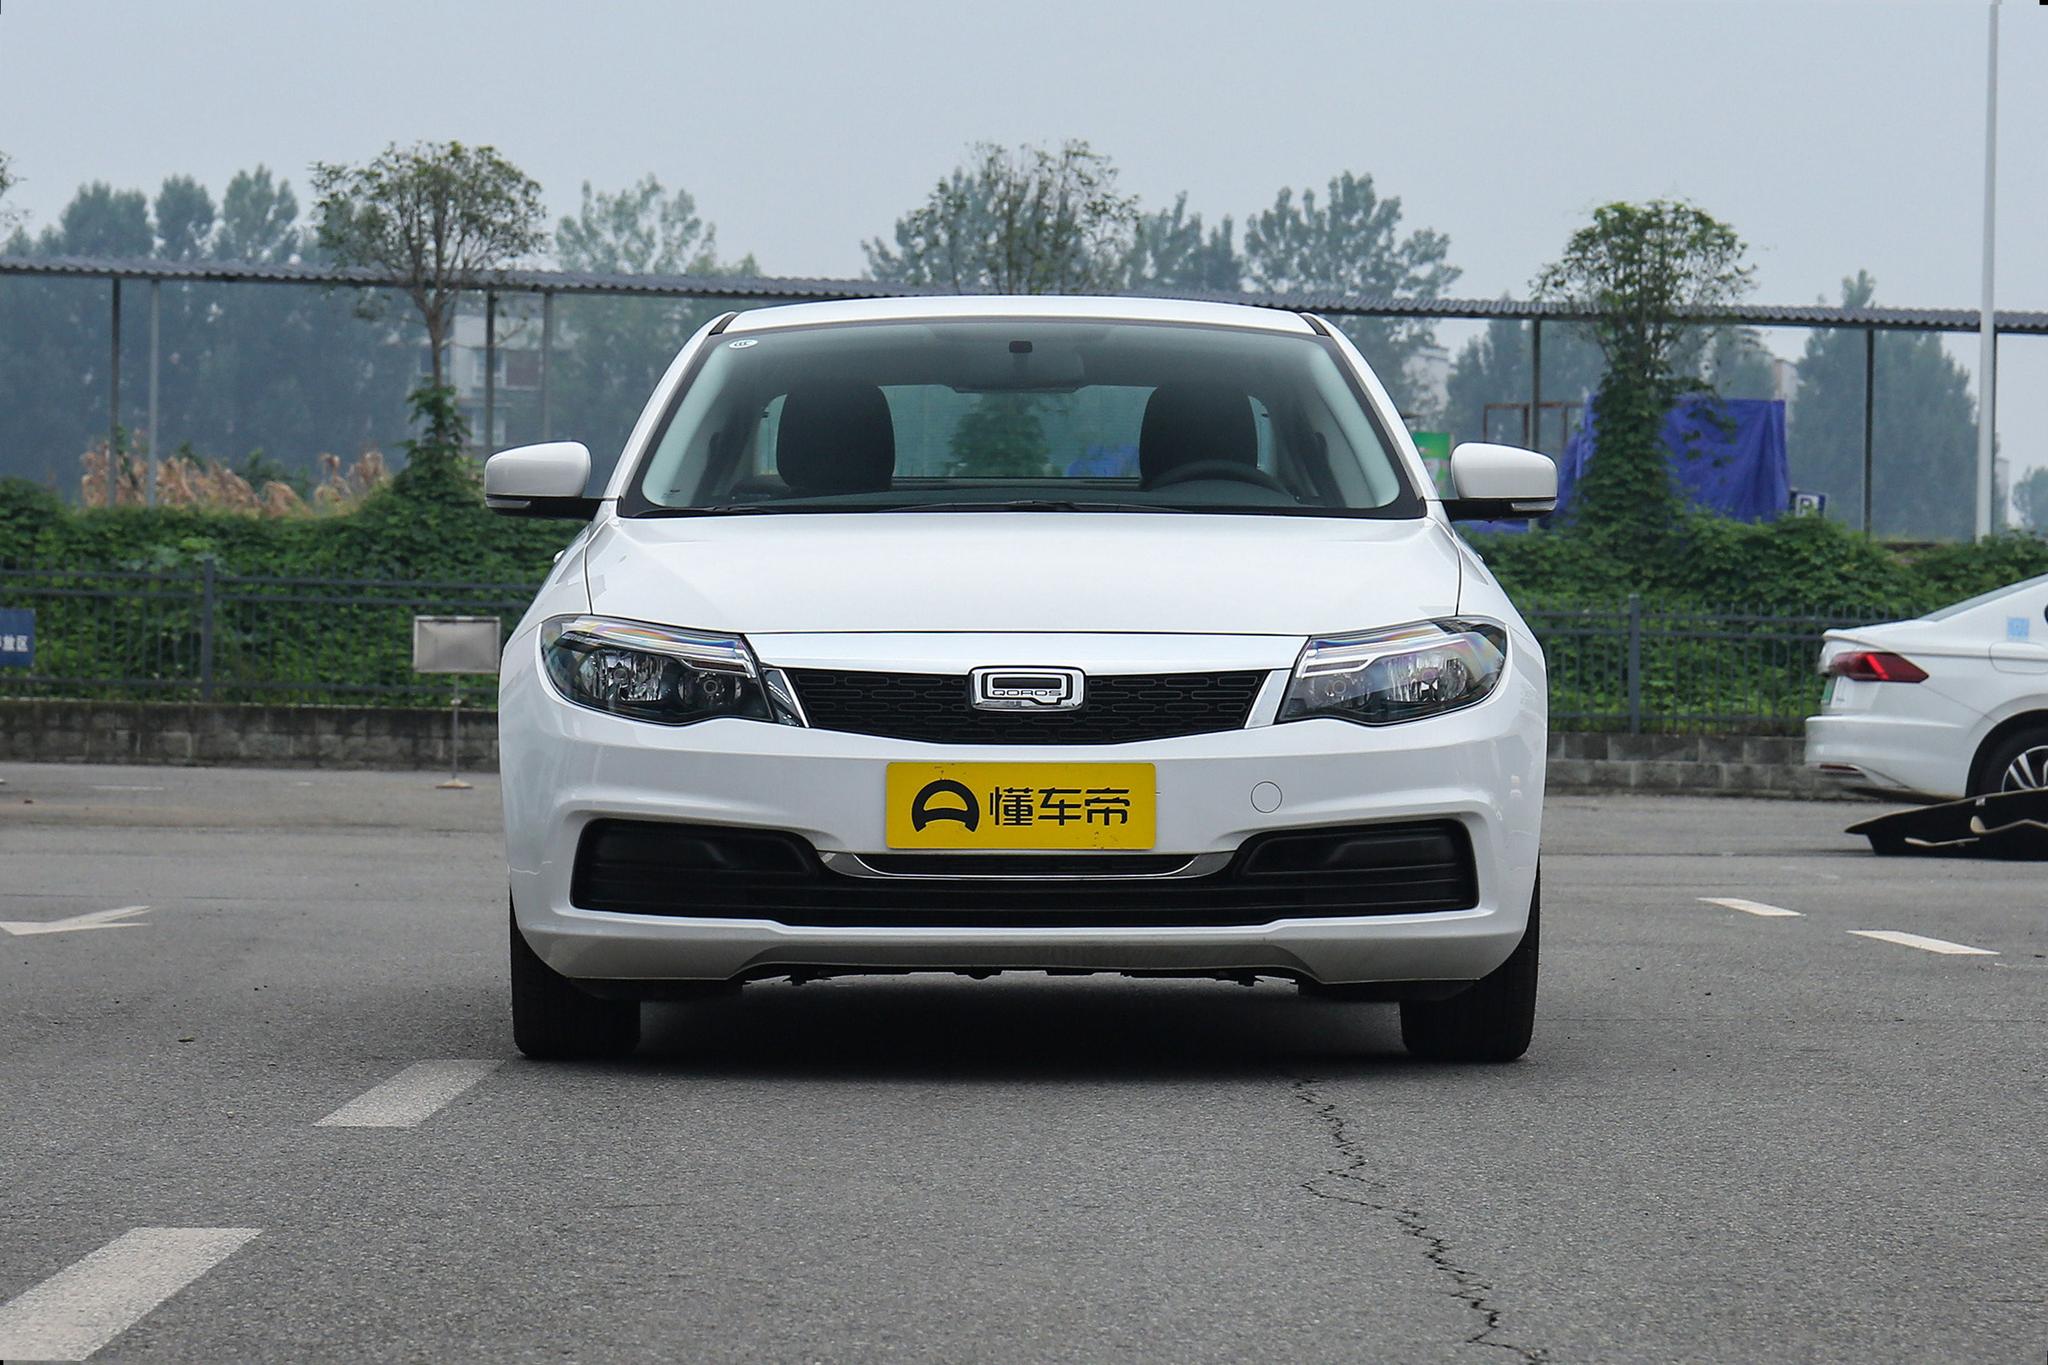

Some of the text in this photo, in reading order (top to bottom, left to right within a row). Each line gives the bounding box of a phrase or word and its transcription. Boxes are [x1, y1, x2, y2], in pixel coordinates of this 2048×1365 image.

[992, 689, 1062, 697] QOROS
[989, 786, 1131, 826] 懂车帝
